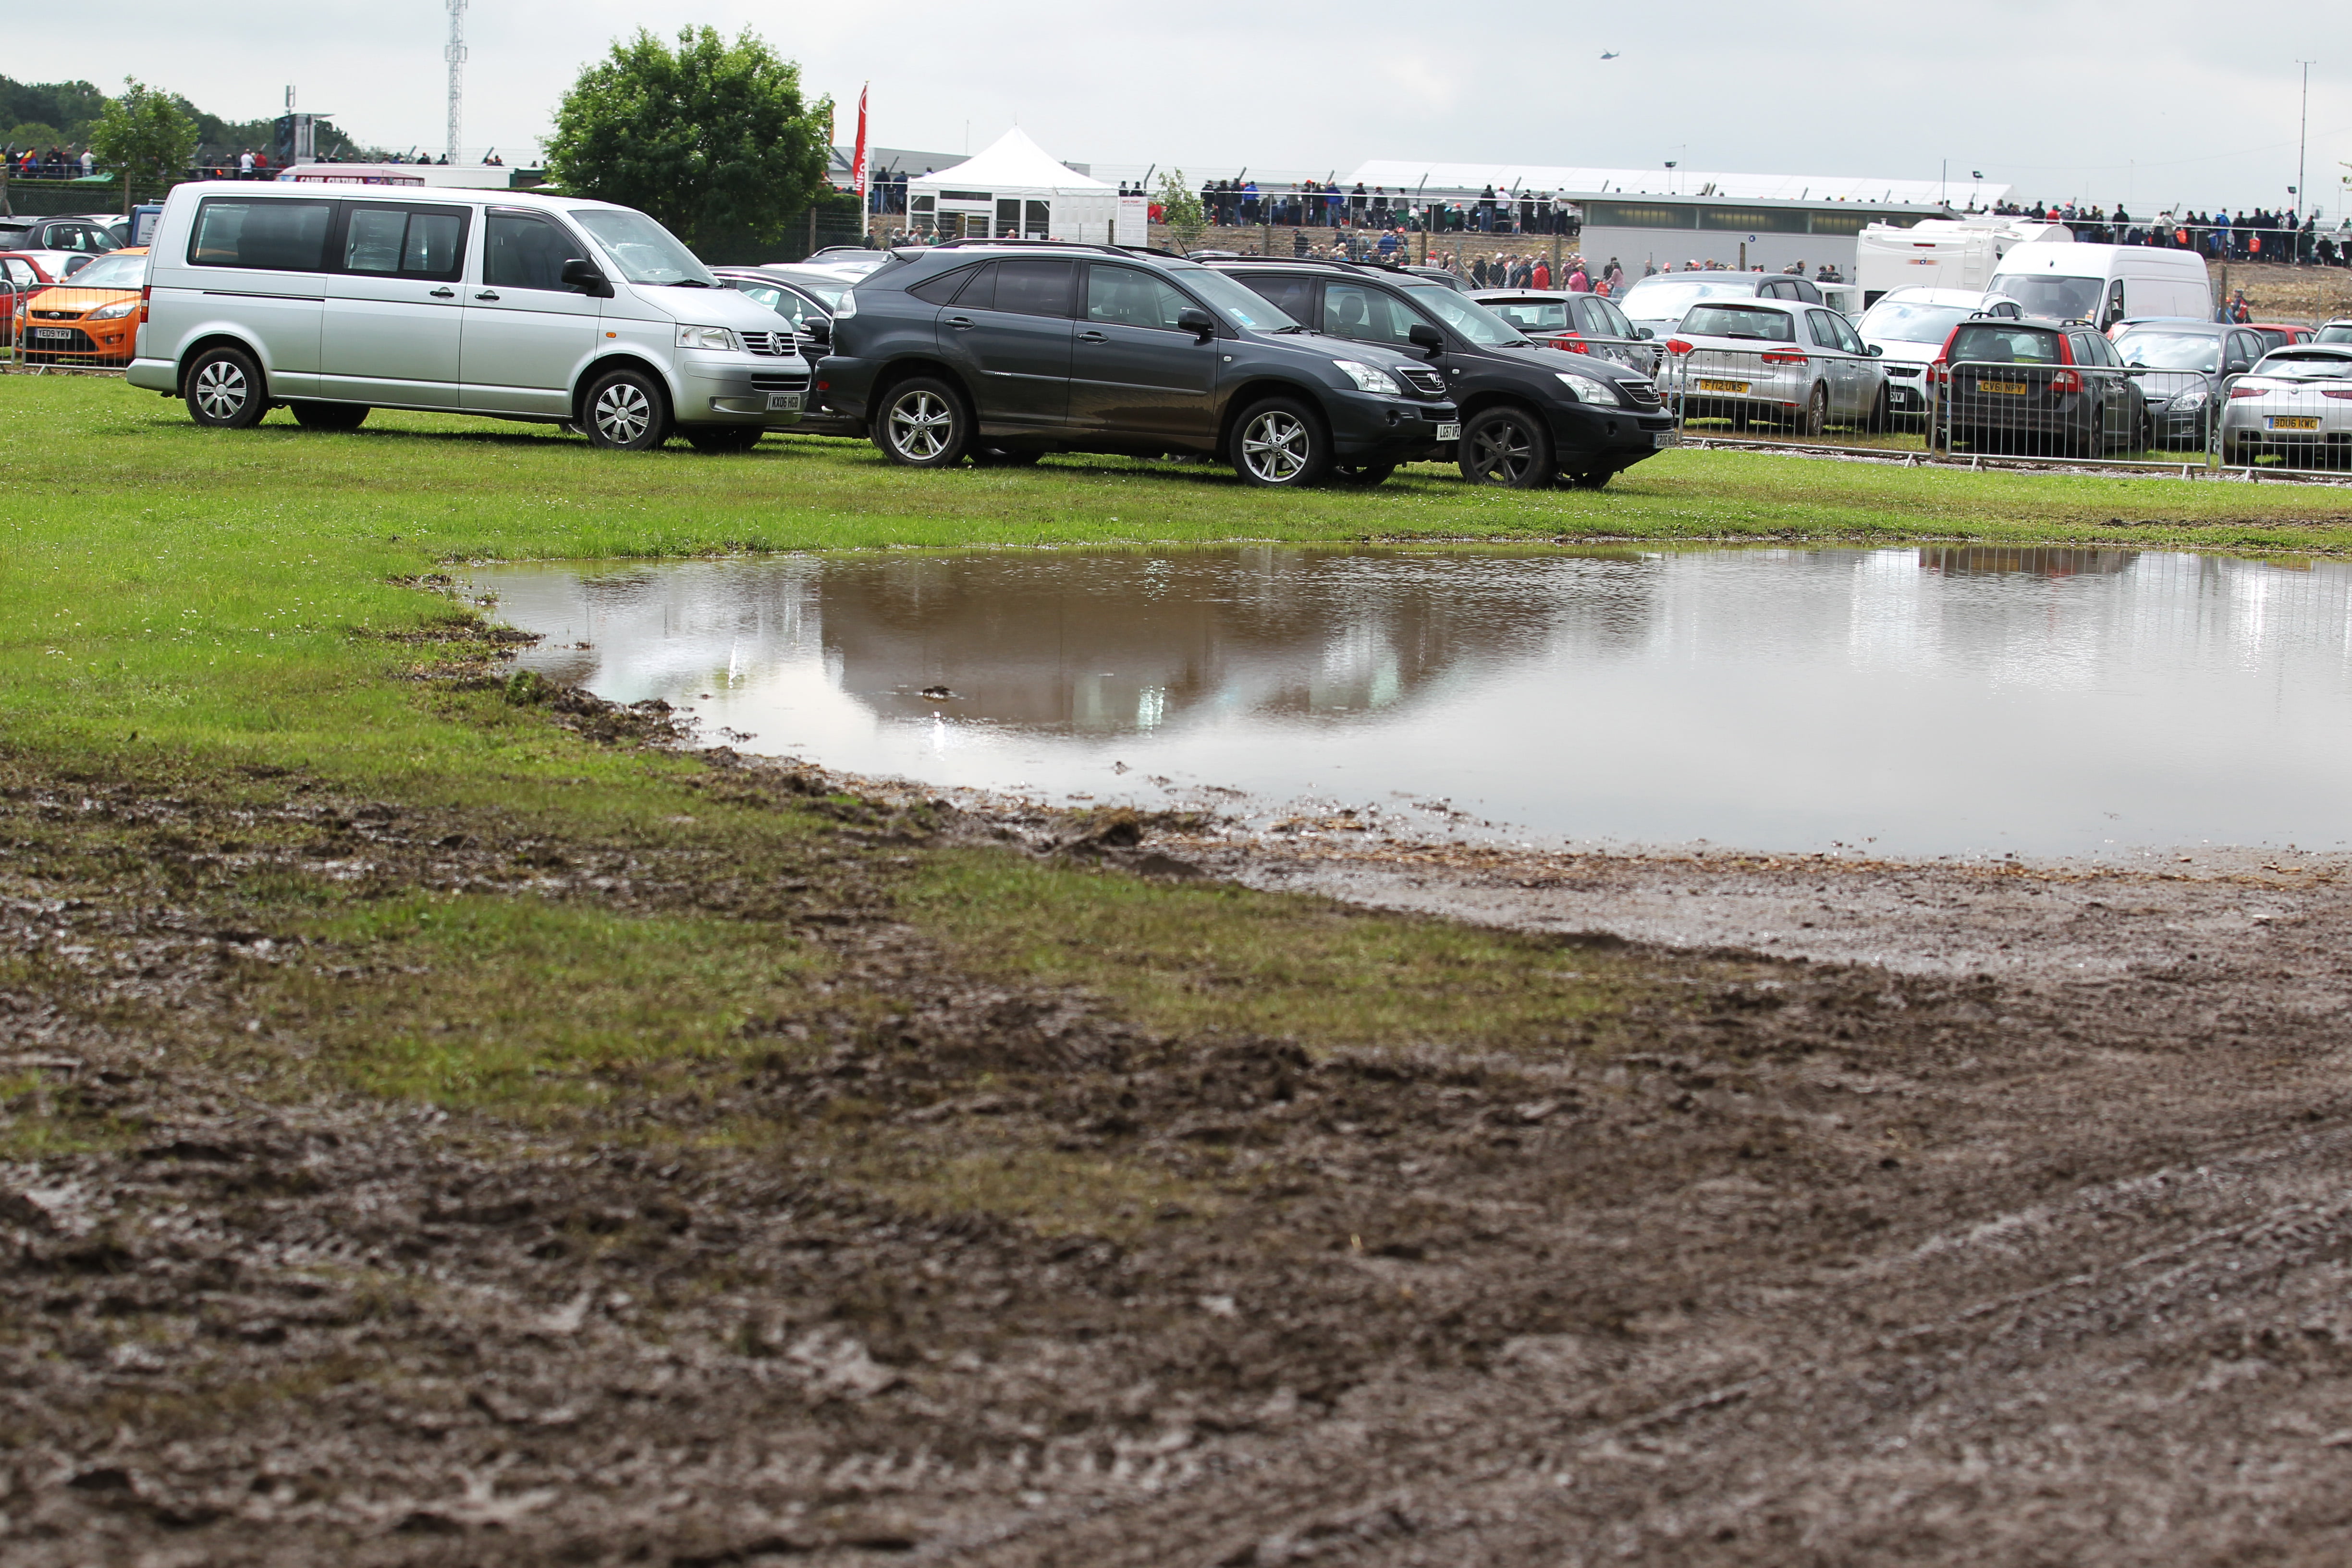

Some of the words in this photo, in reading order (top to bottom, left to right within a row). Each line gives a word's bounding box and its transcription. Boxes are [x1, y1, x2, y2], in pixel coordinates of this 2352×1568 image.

[772, 396, 787, 408] KX06
[2299, 419, 2316, 428] KWC
[1440, 426, 1452, 438] LG57
